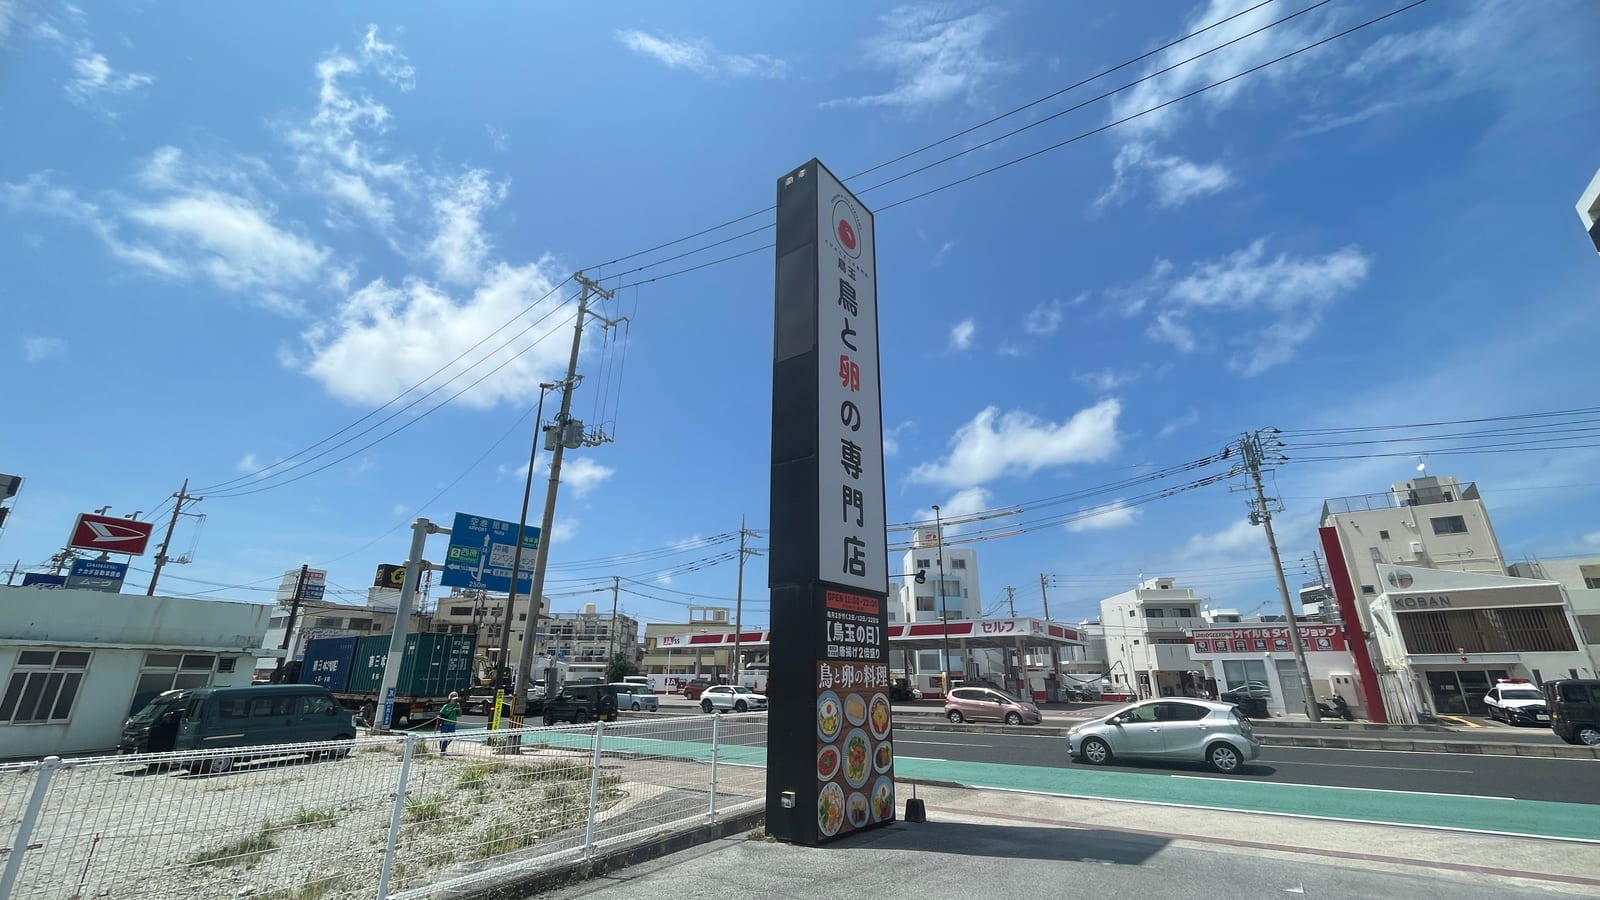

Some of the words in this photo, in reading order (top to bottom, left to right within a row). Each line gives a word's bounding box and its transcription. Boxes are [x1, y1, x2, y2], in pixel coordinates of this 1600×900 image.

[838, 278, 865, 577] 鳥と卵の専門店
[468, 580, 487, 588] 250m
[828, 592, 844, 602] OPEN
[1394, 596, 1452, 608] KOBAN
[981, 621, 1015, 633] セルフ
[1234, 626, 1337, 639] オイル&タイショップ
[819, 663, 888, 688] 鳥と卵の料理
